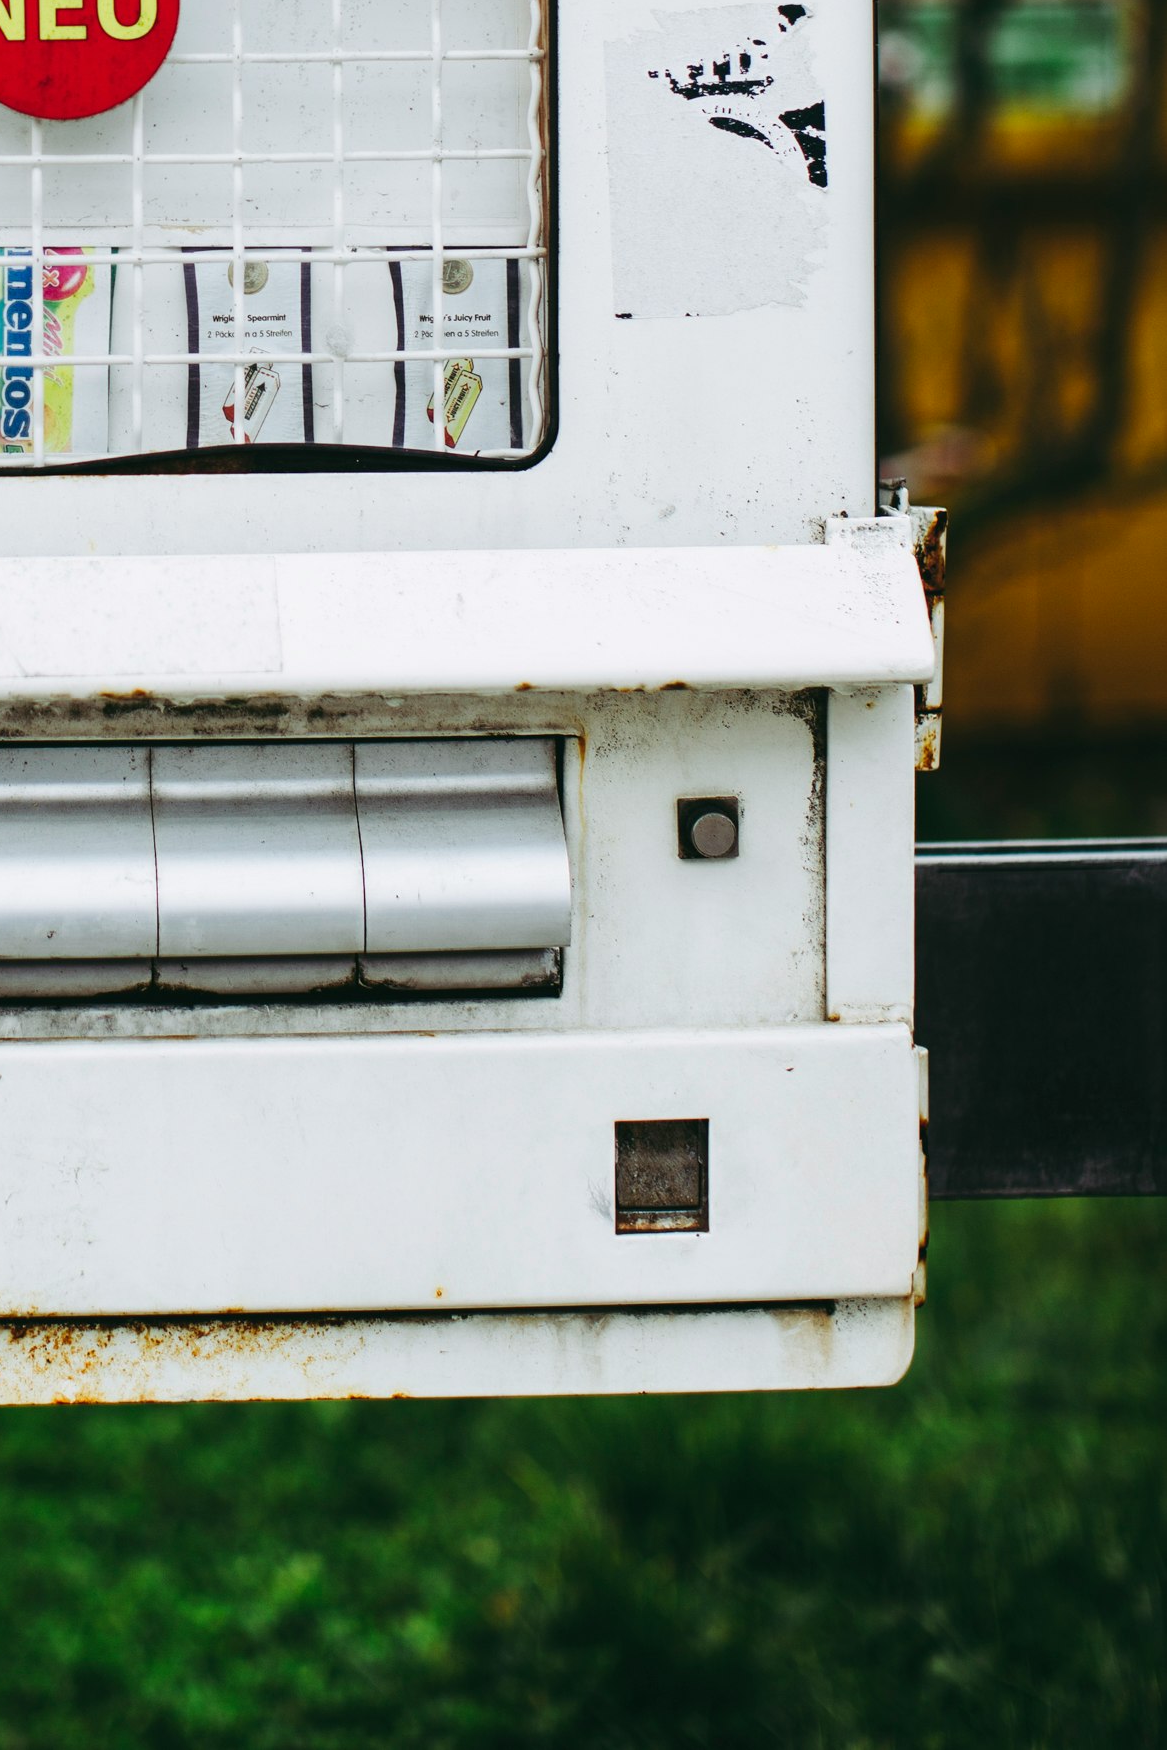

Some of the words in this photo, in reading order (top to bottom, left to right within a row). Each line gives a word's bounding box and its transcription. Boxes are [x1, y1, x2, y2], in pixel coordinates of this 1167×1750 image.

[247, 313, 286, 323] Spearmint
[453, 314, 473, 323] Juicy
[475, 313, 491, 322] Fruit
[207, 331, 212, 339] 2
[259, 330, 264, 338] 5
[265, 329, 293, 338] Streifen
[414, 331, 419, 339] 2
[471, 329, 499, 338] Streifen
